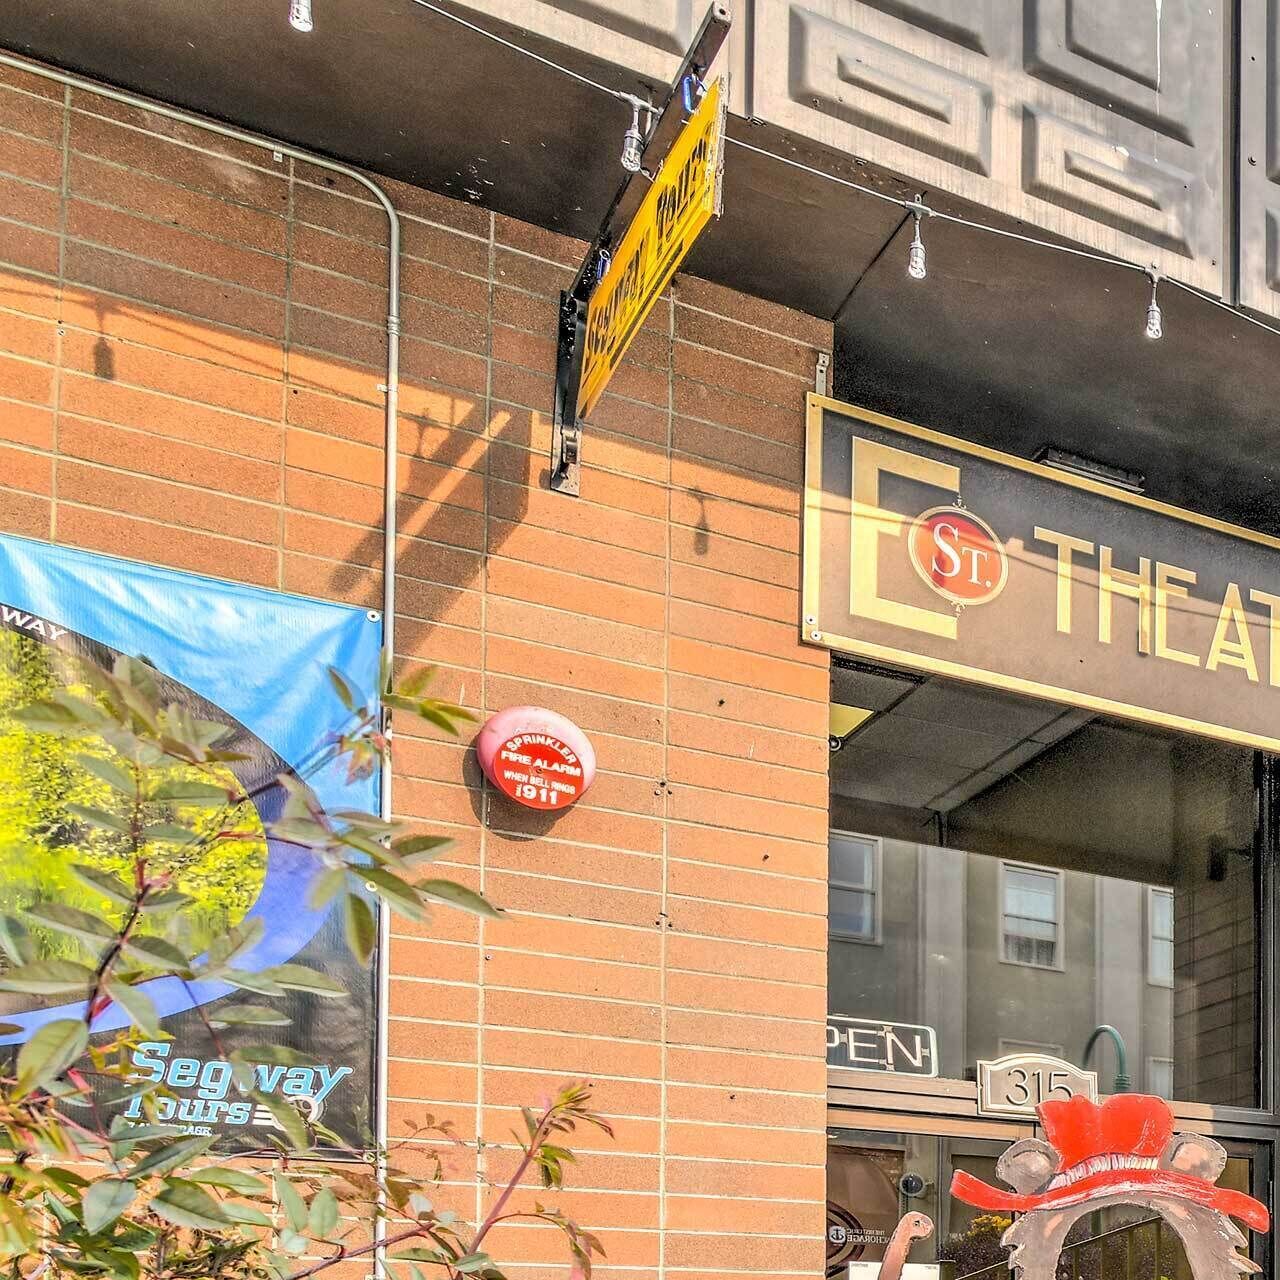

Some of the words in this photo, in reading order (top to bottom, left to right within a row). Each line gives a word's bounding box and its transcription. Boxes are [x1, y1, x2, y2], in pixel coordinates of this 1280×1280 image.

[506, 735, 577, 764] SPRINKLER
[501, 751, 532, 765] FIRE
[533, 759, 581, 777] ALARM
[504, 770, 528, 783] WHEN
[530, 775, 549, 789] BELL
[551, 781, 576, 795] RINGS
[522, 785, 558, 805] 911
[1006, 1067, 1074, 1106] 315
